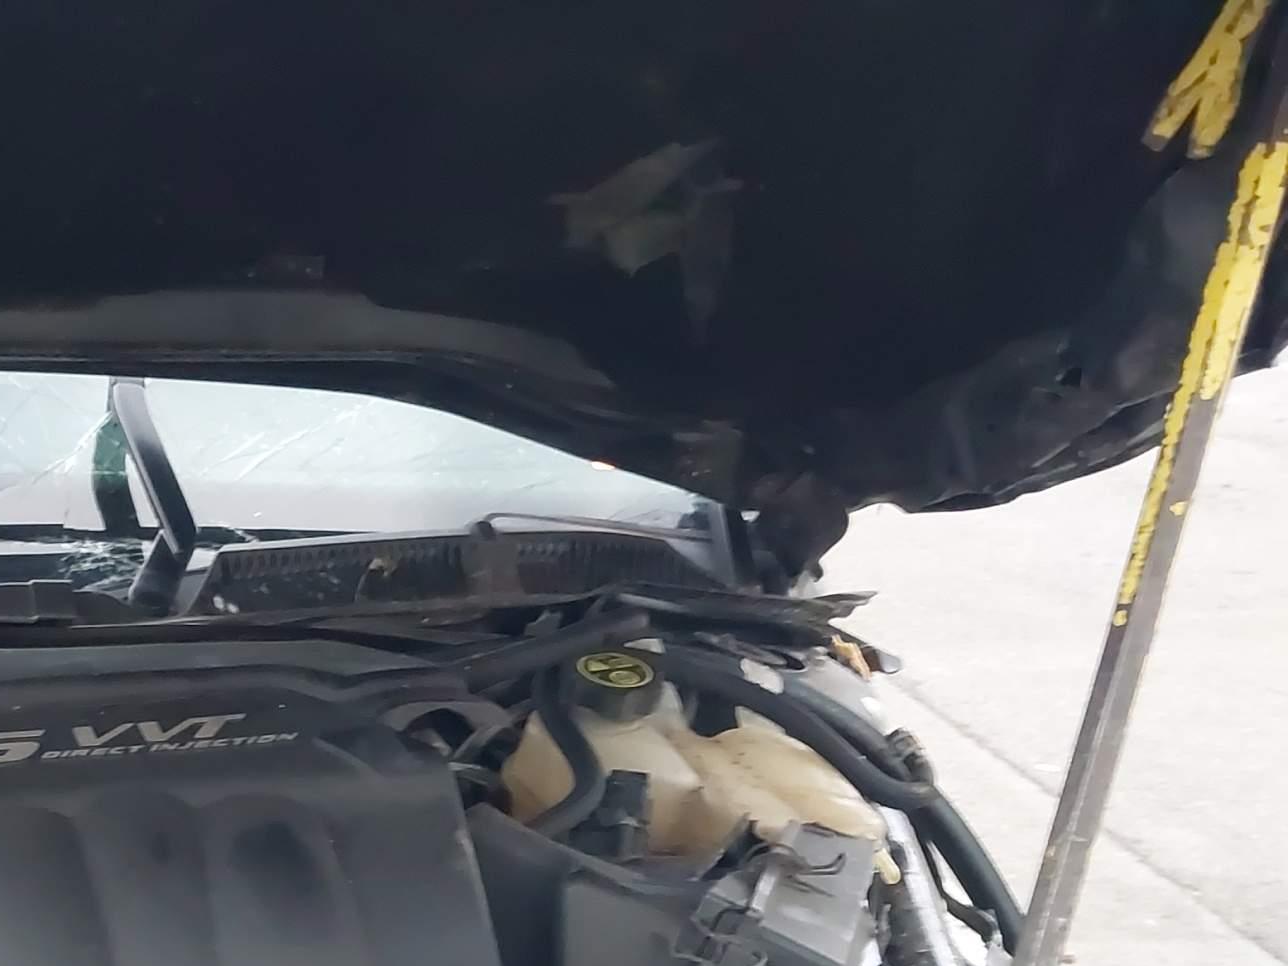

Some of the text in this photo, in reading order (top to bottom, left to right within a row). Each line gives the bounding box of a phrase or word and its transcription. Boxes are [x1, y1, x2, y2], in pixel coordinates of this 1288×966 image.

[72, 713, 247, 747] VVT
[40, 732, 299, 759] DIRECT INJECTION
